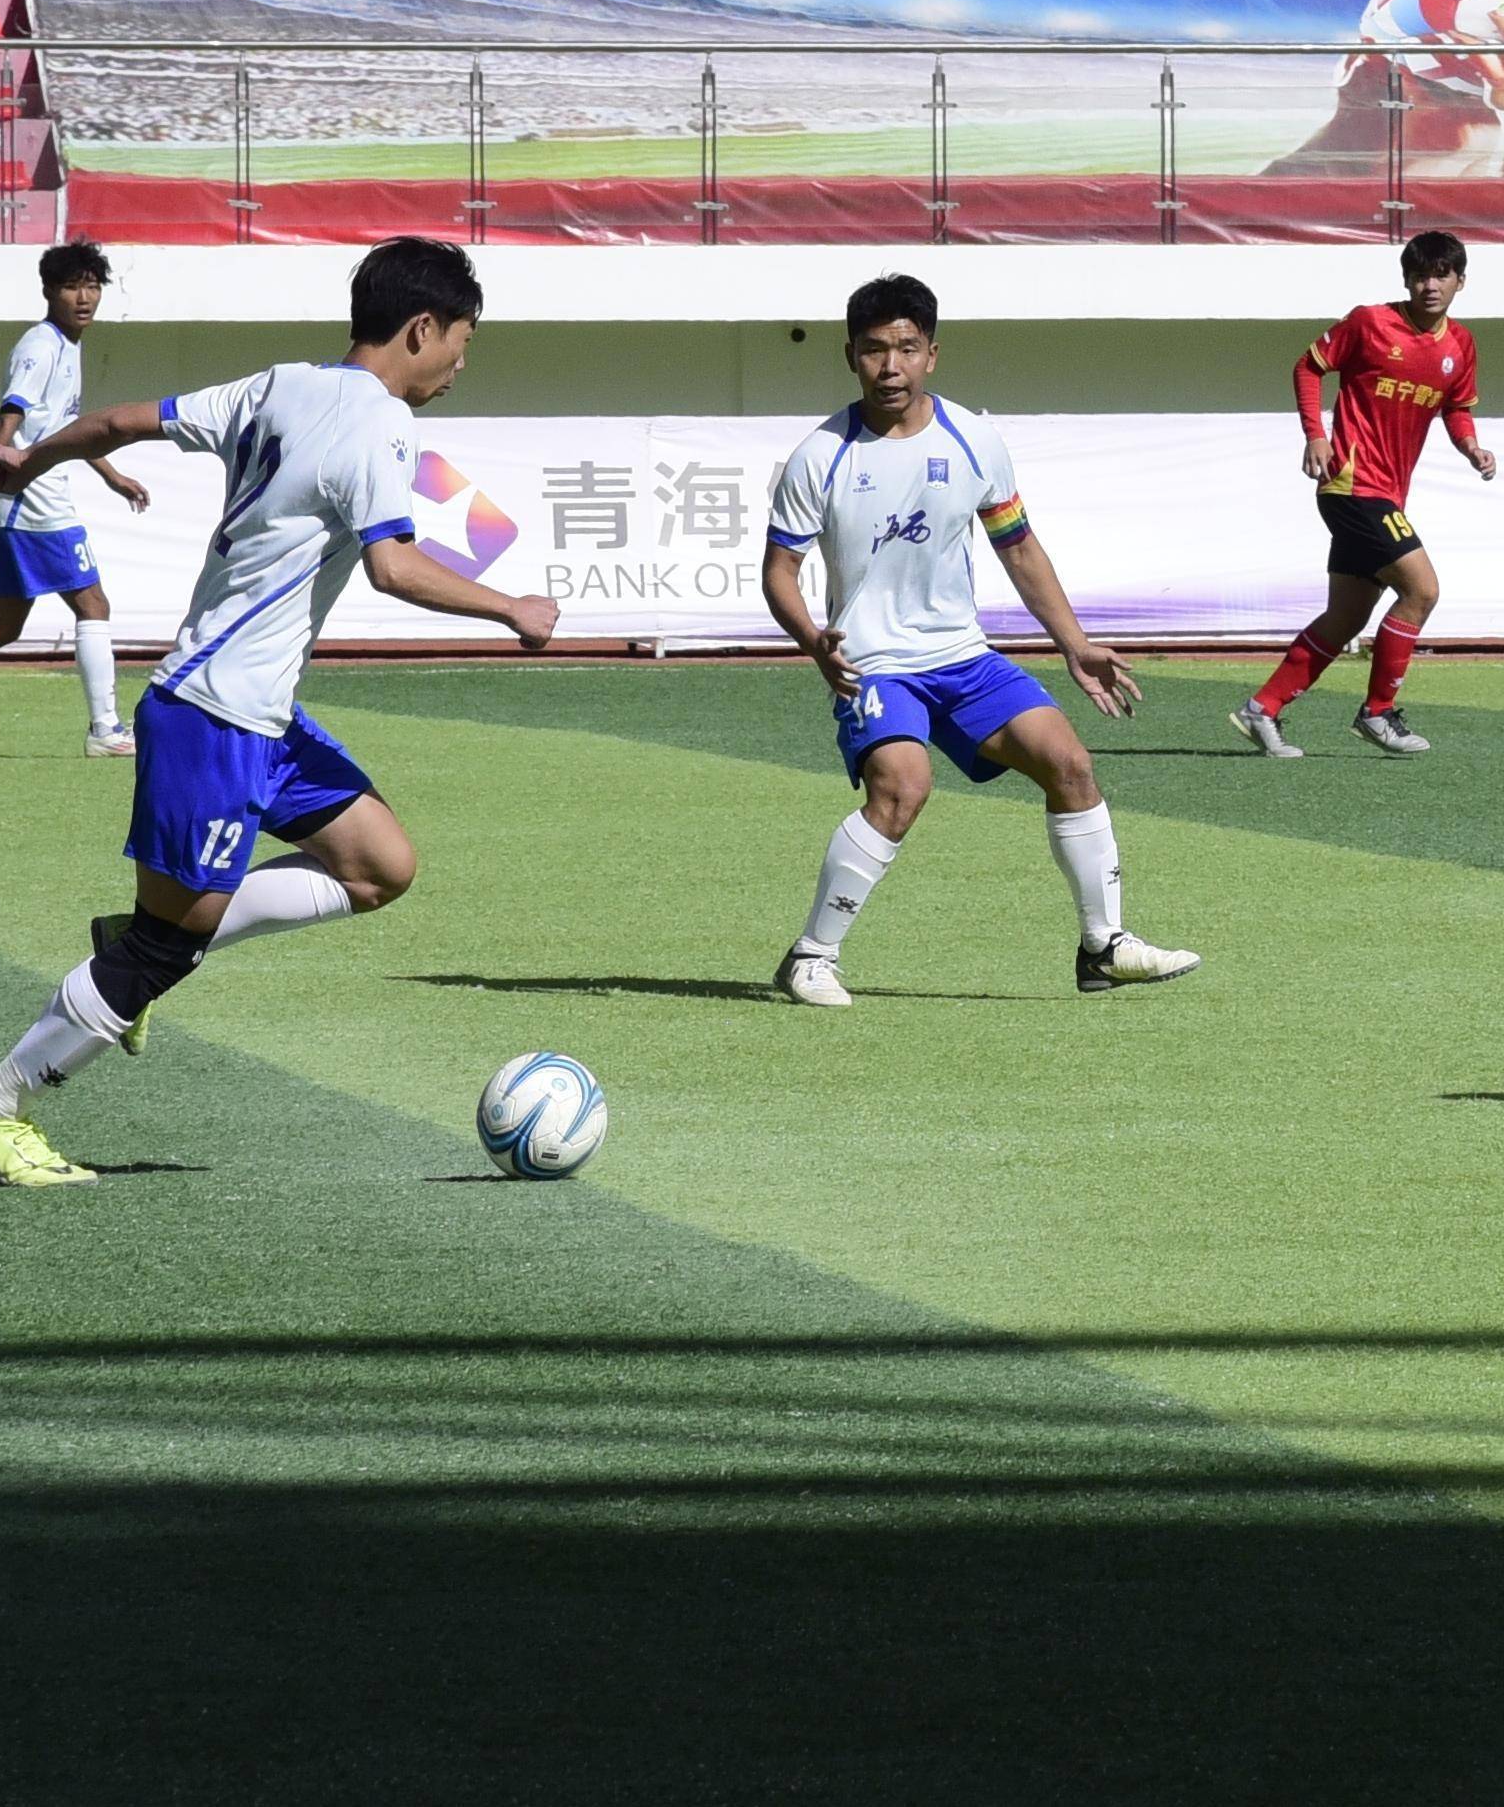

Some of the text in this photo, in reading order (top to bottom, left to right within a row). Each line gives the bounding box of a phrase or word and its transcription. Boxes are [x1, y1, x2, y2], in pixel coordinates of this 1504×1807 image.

[541, 460, 787, 551] 青海
[1381, 510, 1414, 543] 19
[544, 562, 686, 600] BANK
[695, 562, 756, 598] OF
[198, 818, 244, 870] 12
